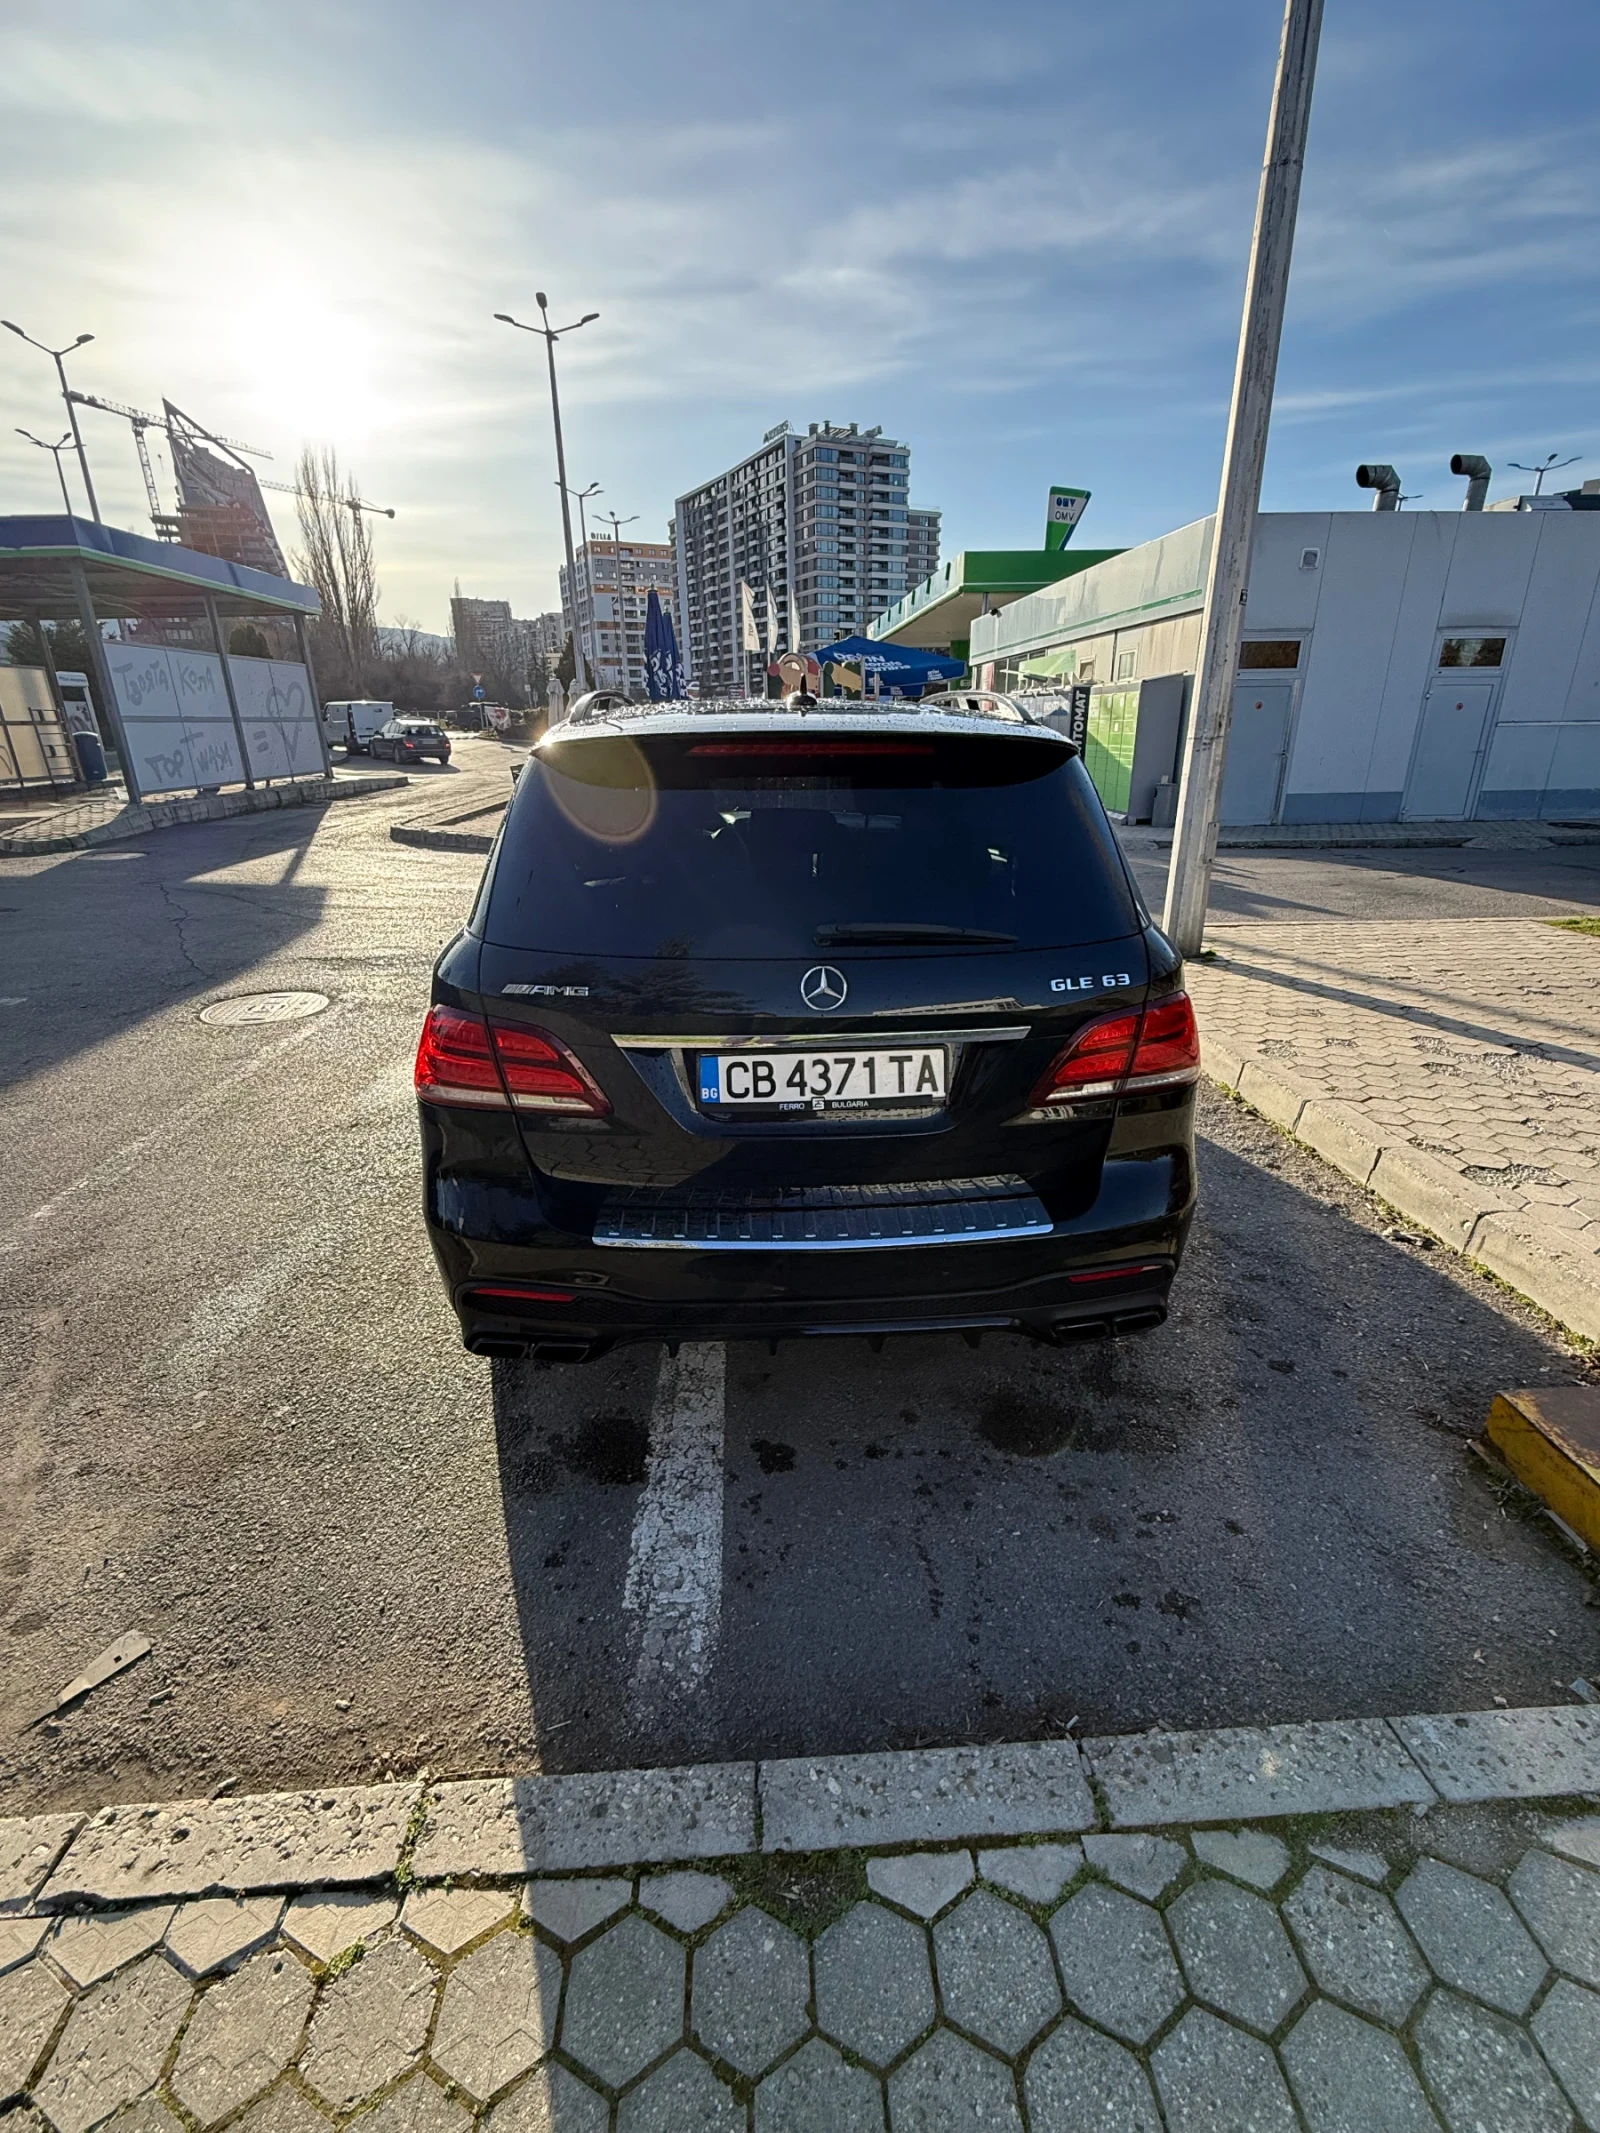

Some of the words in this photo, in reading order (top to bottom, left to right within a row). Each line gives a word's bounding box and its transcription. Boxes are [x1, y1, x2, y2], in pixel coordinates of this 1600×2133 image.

[1055, 511, 1075, 521] OMV
[1050, 976, 1094, 992] GLE
[1101, 973, 1131, 987] 63
[529, 984, 589, 996] AMG
[786, 1056, 876, 1097] 4371
[701, 1087, 718, 1100] BG
[779, 1102, 806, 1111] FERRO
[831, 1100, 869, 1109] BULGARIA
